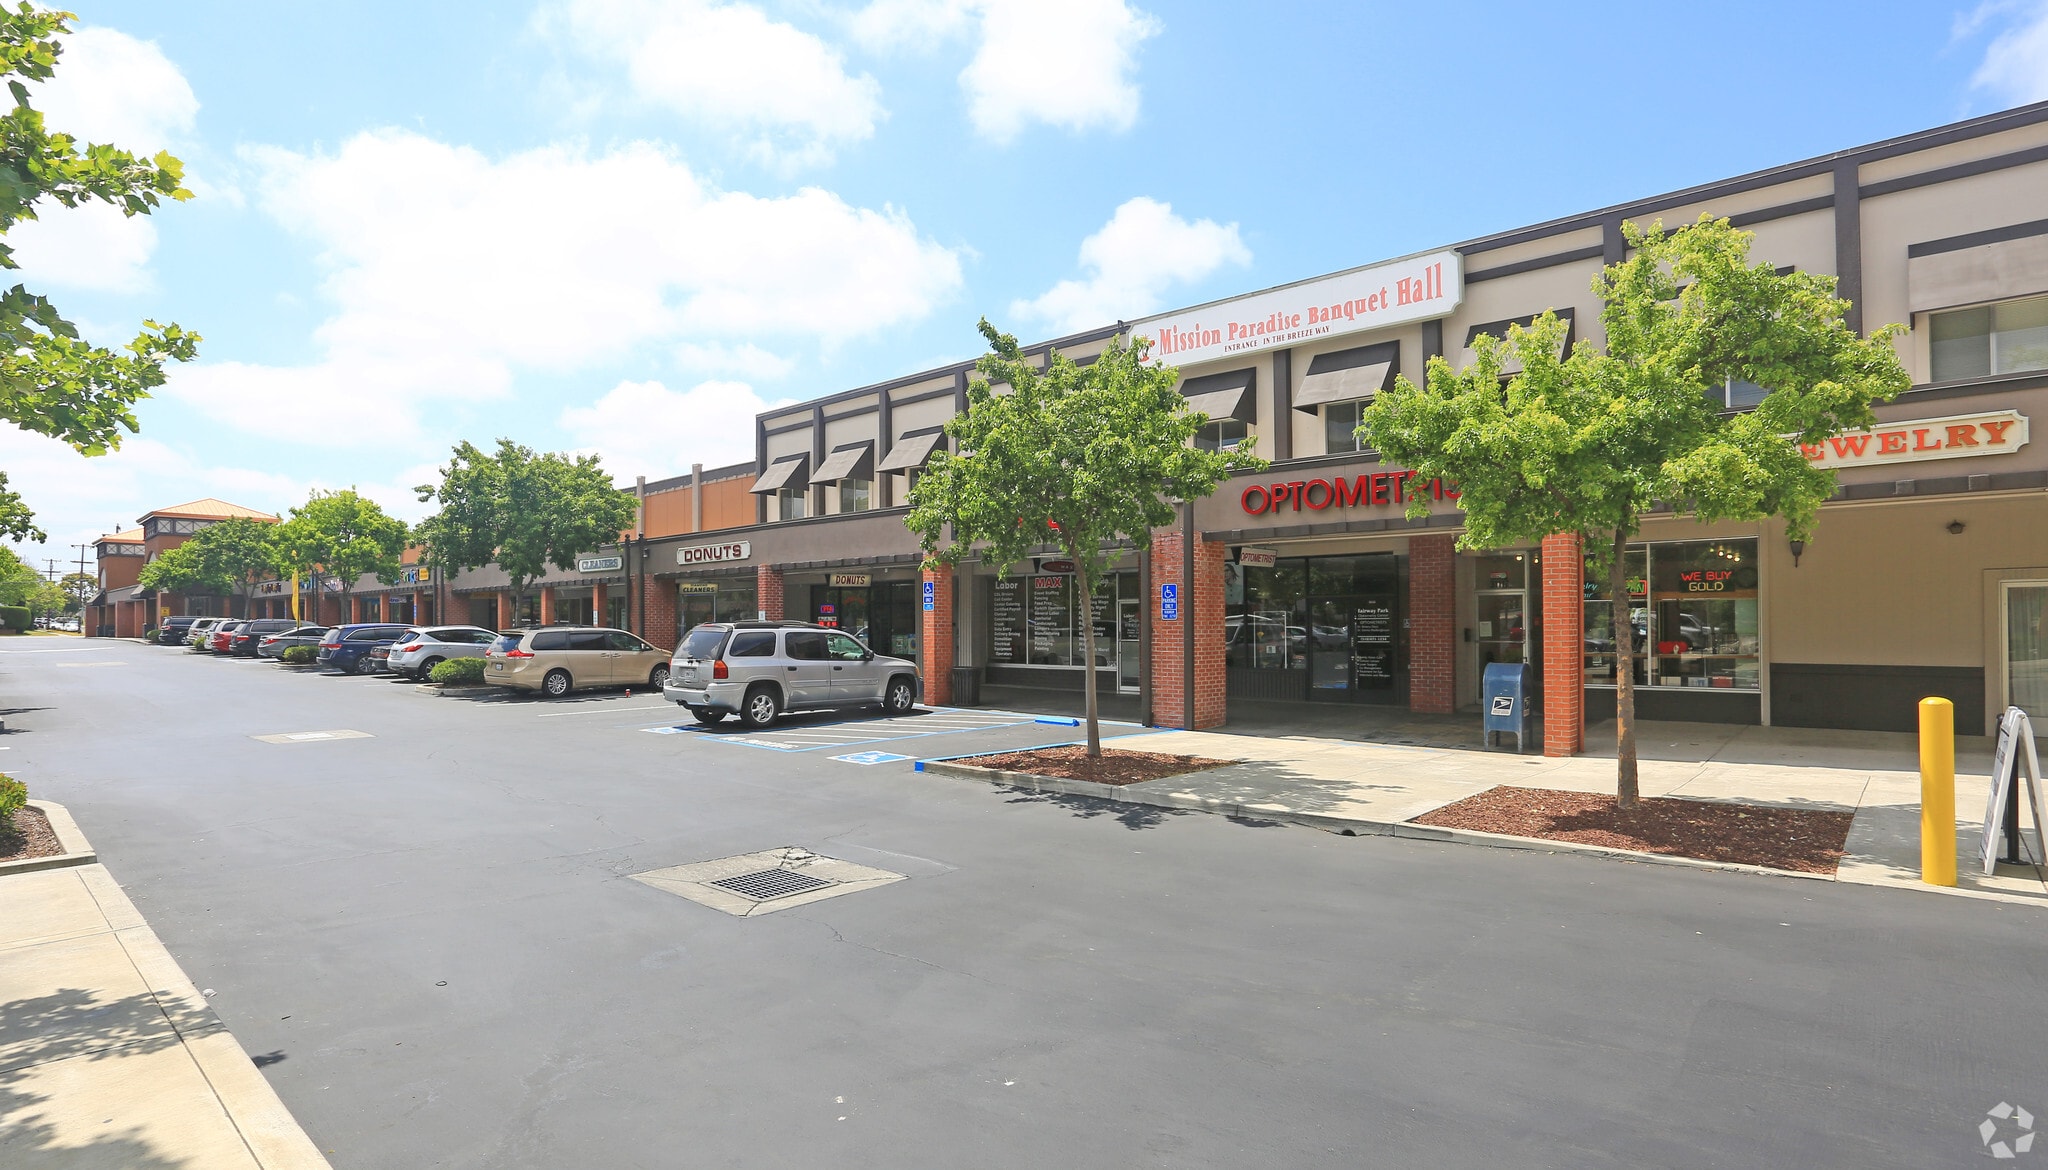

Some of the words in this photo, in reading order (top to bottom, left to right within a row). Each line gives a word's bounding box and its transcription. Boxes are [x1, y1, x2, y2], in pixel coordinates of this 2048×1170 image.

[1159, 323, 1221, 355] Mission
[1228, 311, 1300, 341] Paradise
[1308, 287, 1388, 325] Banquet
[1396, 262, 1443, 306] Hall
[1224, 339, 1258, 353] ENTRANCE
[1263, 337, 1270, 345] IN
[1272, 333, 1285, 343] THE
[1287, 328, 1313, 340] BREEZE
[1315, 325, 1330, 335] WAY
[1800, 420, 2014, 460] EWELRY
[684, 544, 742, 563] DONUTS
[1240, 551, 1276, 564] OPTOMETRIST
[582, 558, 618, 570] CLEANERS
[835, 575, 866, 585] DONUTS
[1681, 571, 1702, 581] WE
[1705, 571, 1732, 581] BUY
[995, 581, 1018, 589] Labor
[1035, 577, 1062, 588] MAX
[1688, 581, 1724, 592] GOLD
